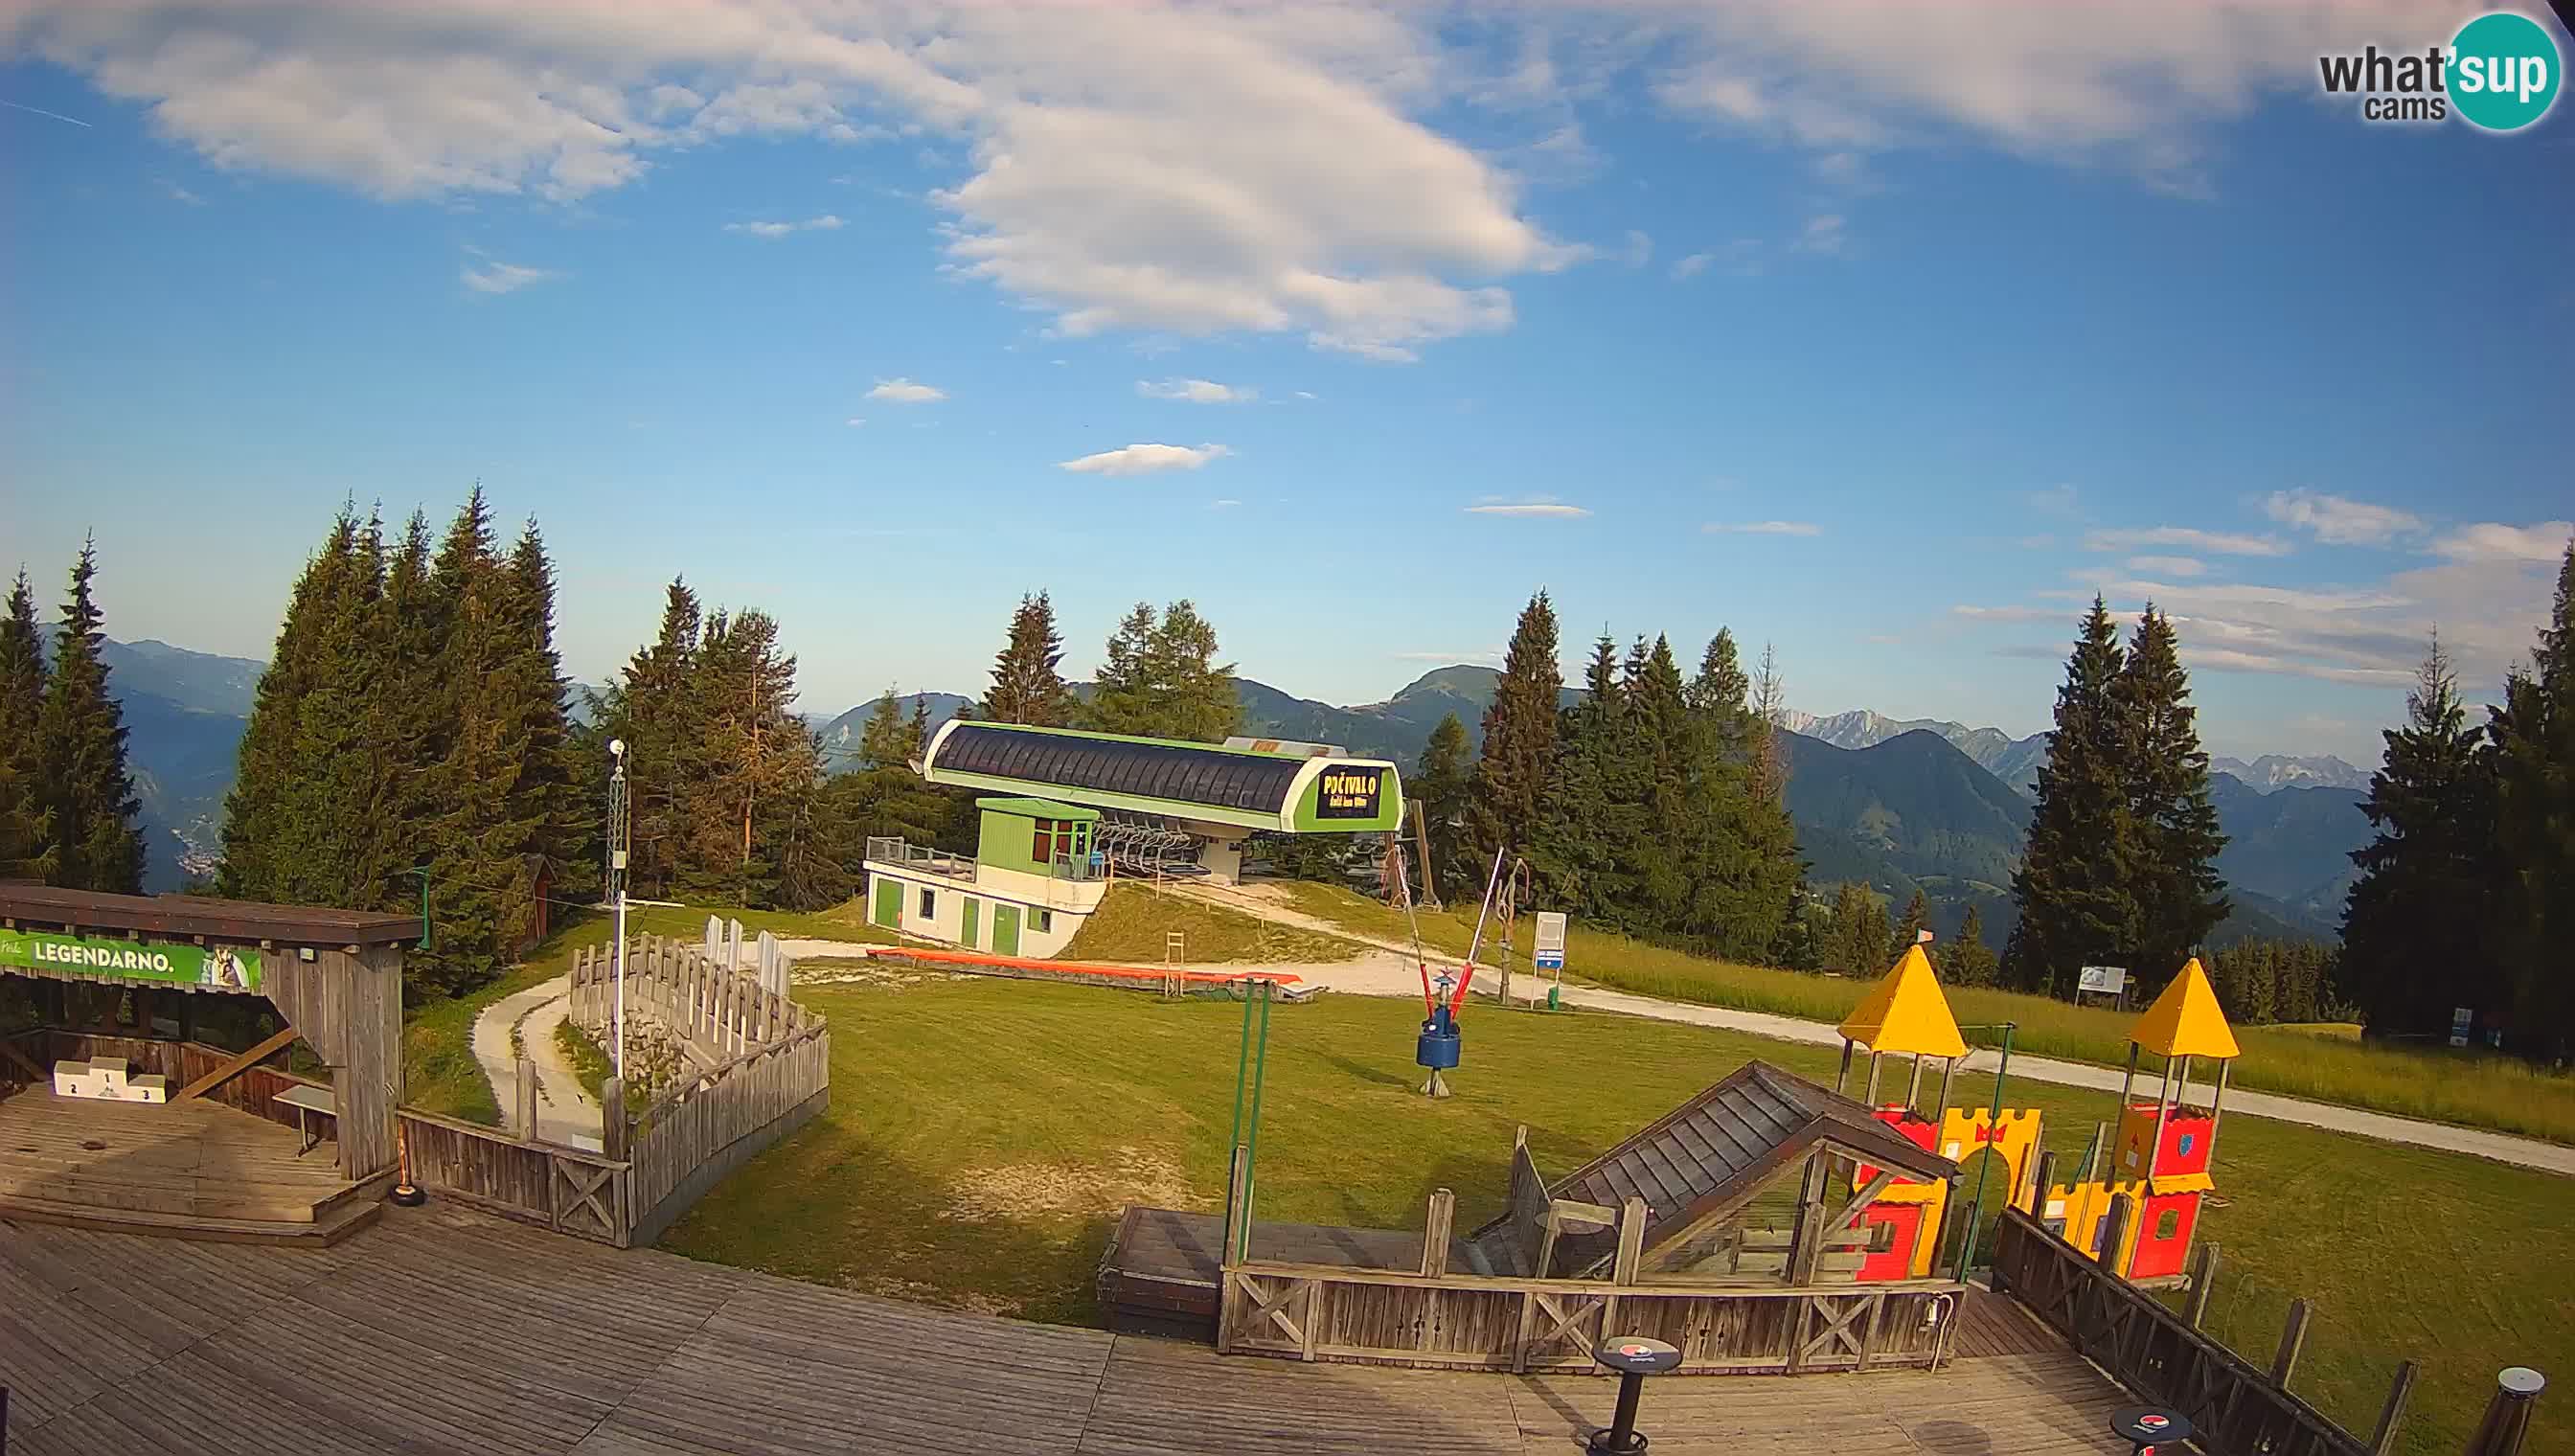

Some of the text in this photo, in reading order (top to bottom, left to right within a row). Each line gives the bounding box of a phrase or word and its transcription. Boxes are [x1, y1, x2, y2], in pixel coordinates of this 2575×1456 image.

[34, 942, 174, 973] LEGENDARNO.
[104, 1073, 111, 1083] 1
[70, 1084, 78, 1094] 2
[143, 1090, 150, 1100] 3
